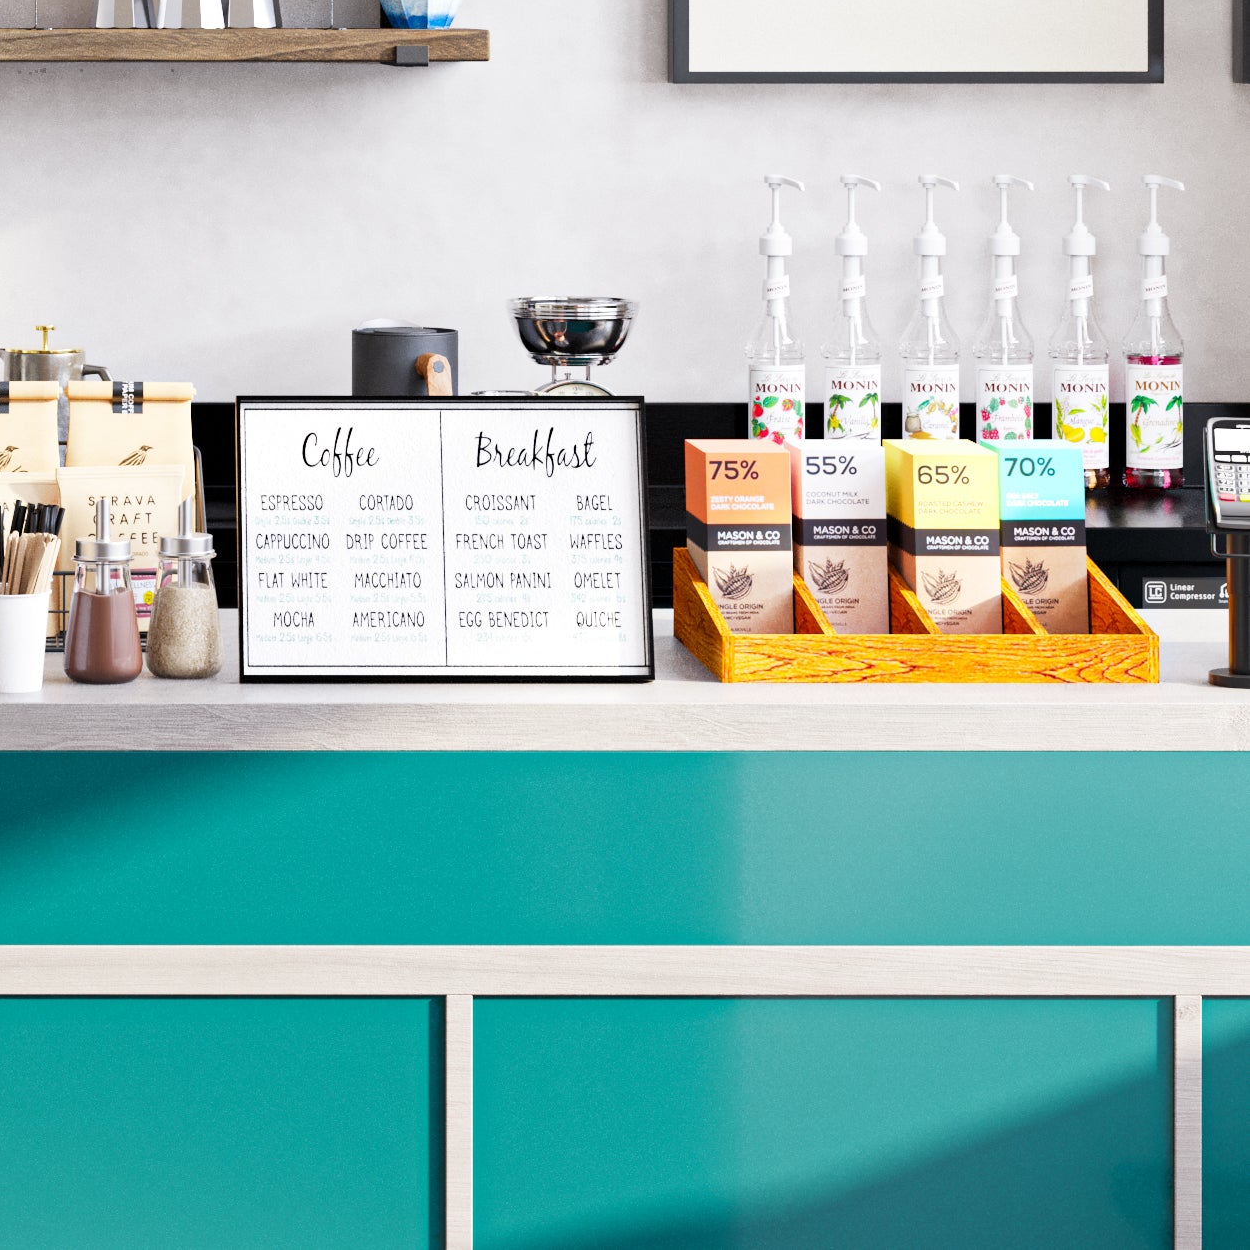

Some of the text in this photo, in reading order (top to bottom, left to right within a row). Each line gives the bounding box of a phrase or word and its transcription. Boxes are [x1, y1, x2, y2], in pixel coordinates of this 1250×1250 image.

[756, 383, 801, 393] MONIN
[831, 380, 877, 390] MONIN
[910, 383, 956, 392] MONIN
[985, 383, 1030, 392] MONIN
[1061, 383, 1106, 392] MONIN
[1135, 380, 1180, 391] MONIN
[302, 427, 379, 478] Coffee
[476, 427, 596, 478] Breakfast
[709, 460, 759, 480] 75%
[806, 456, 857, 475] 55%
[1005, 457, 1055, 476] 70%
[918, 465, 969, 484] 65%
[261, 494, 323, 511] ESPRESSO
[359, 494, 413, 511] CORTADO
[465, 494, 536, 511] CROISSANT
[576, 494, 612, 511] BAGEL
[93, 512, 152, 525] RAFT
[718, 531, 780, 540] MASON & CO
[813, 526, 876, 534] MASON & CO
[1013, 527, 1075, 535] MASON & CO
[256, 533, 330, 550] CAPPUCCINO
[346, 533, 427, 550] DRIP COFFEE
[456, 533, 548, 550] FRENCH TOAST
[570, 533, 623, 550] WAFFLES
[926, 536, 989, 545] MASON & CO
[258, 572, 328, 589] FLAT WHITE
[355, 572, 422, 589] MACCHIATO
[455, 572, 552, 589] SALMON PANINI
[574, 572, 621, 589] OMELET
[1170, 593, 1215, 601] Compressor
[273, 611, 314, 628] MOCHA
[353, 611, 425, 628] AMERICANO
[459, 611, 548, 628] EGG BENEDICT
[576, 611, 622, 628] QUICHE
